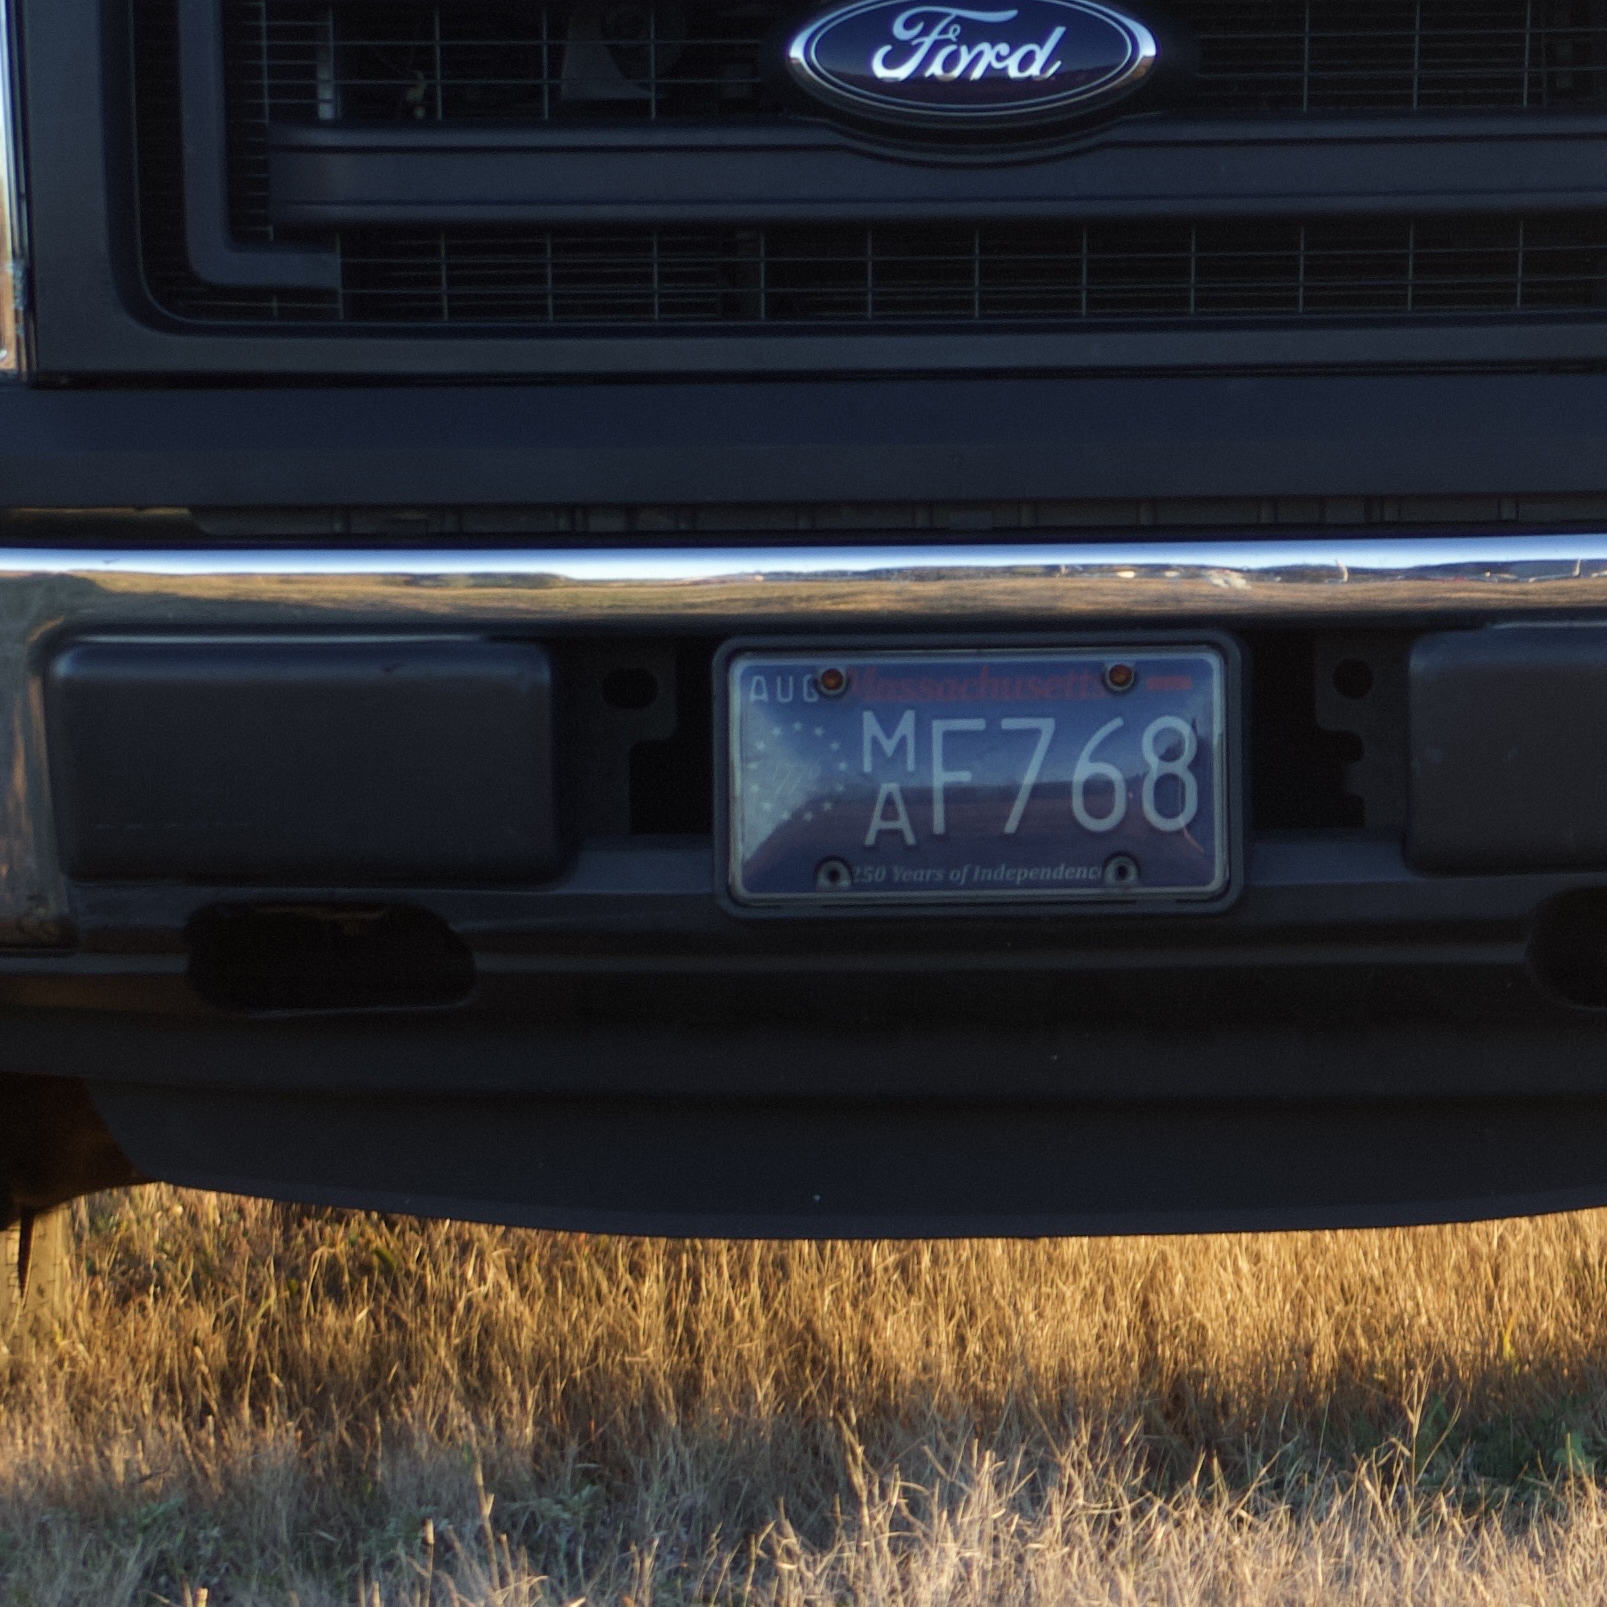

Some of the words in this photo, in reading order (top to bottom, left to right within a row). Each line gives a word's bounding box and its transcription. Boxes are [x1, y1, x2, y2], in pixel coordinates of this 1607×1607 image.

[871, 5, 1066, 81] Ford
[749, 674, 820, 703] AUG
[848, 665, 1109, 702] Massachusetts
[852, 866, 886, 883] 250
[891, 865, 944, 882] Years
[949, 864, 971, 885] of
[973, 862, 1101, 885] Independenc
